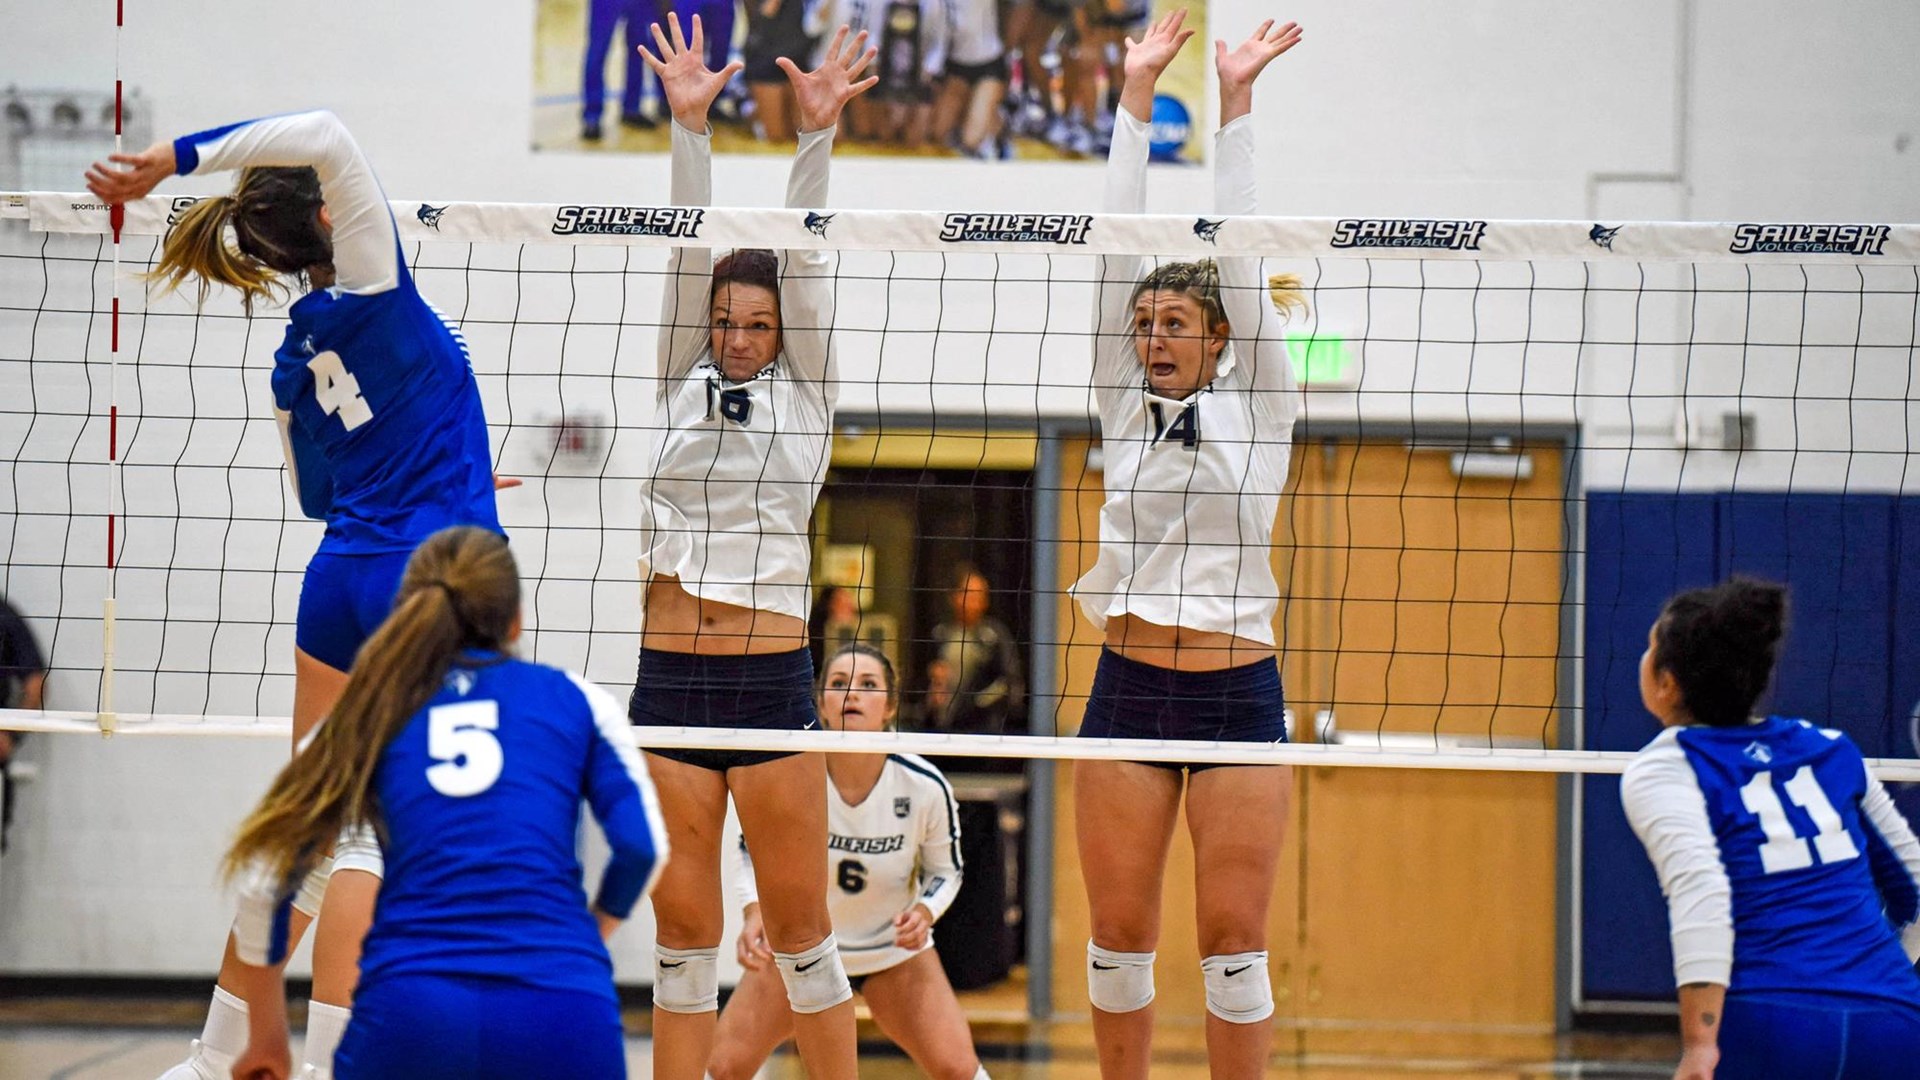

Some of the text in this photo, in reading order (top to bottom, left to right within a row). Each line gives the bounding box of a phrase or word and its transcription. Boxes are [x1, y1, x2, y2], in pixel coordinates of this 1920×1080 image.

[71, 203, 95, 211] sports
[552, 206, 705, 238] SAILFISH
[576, 224, 667, 235] VOLLEYBALL
[940, 213, 1094, 244] SAILFISH
[964, 231, 1056, 242] VOLLEYBALL
[1331, 219, 1488, 250] SAILFISH
[1355, 237, 1449, 248] VOLLEYBALL
[1730, 224, 1891, 256] SAILFISH
[1755, 242, 1851, 253] VOLLEYBALL
[306, 350, 374, 432] 4
[703, 377, 754, 428] 16
[1148, 401, 1201, 451] 14
[425, 699, 504, 797] 5
[1739, 765, 1860, 874] 11
[828, 833, 904, 854] ILFISH
[837, 858, 868, 895] 6
